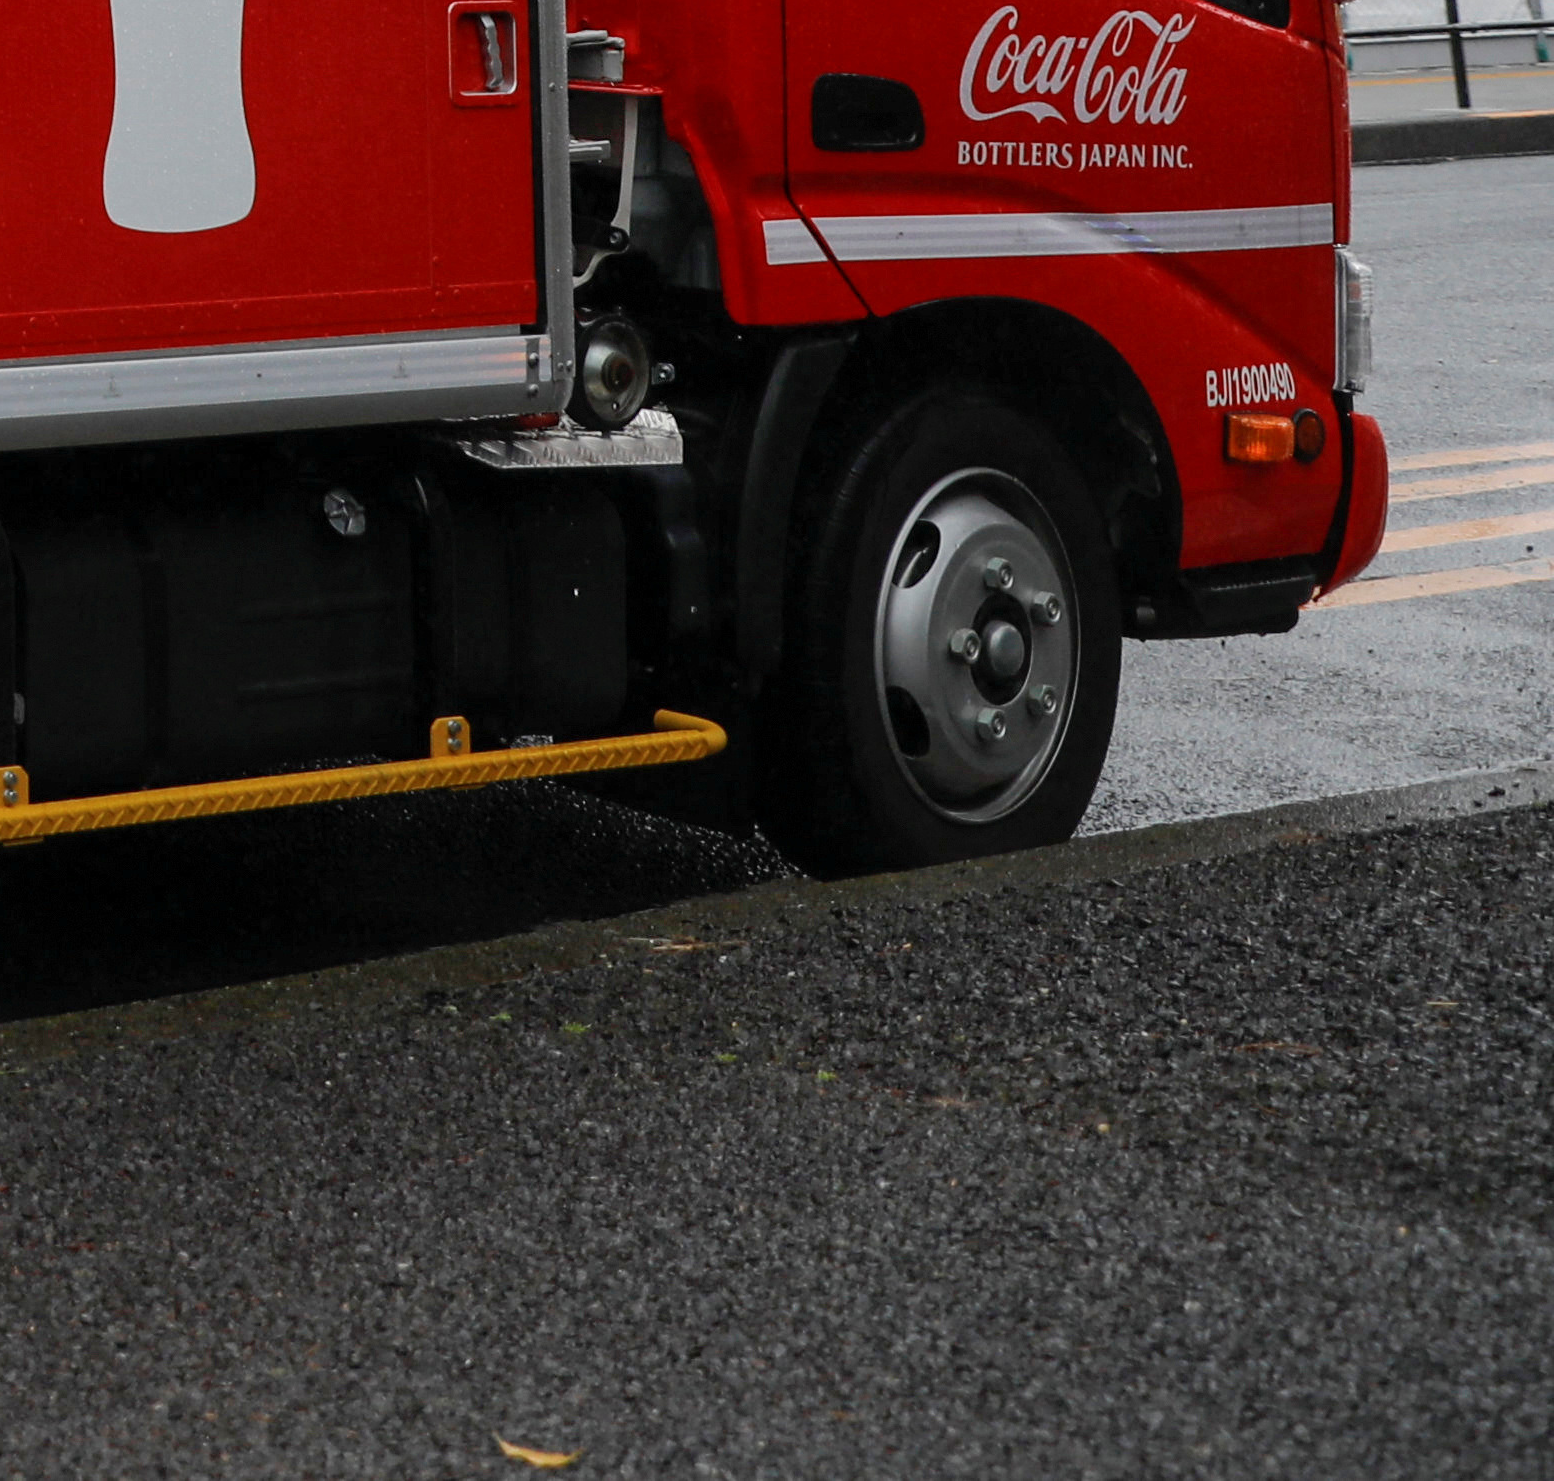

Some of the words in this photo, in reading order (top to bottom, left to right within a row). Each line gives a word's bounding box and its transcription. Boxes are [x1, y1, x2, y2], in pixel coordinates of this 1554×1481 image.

[958, 4, 1197, 126] Coca-Cola
[957, 141, 1073, 169] BOTTLERS
[1079, 143, 1146, 172] JAPAN
[1152, 144, 1193, 169] INC.
